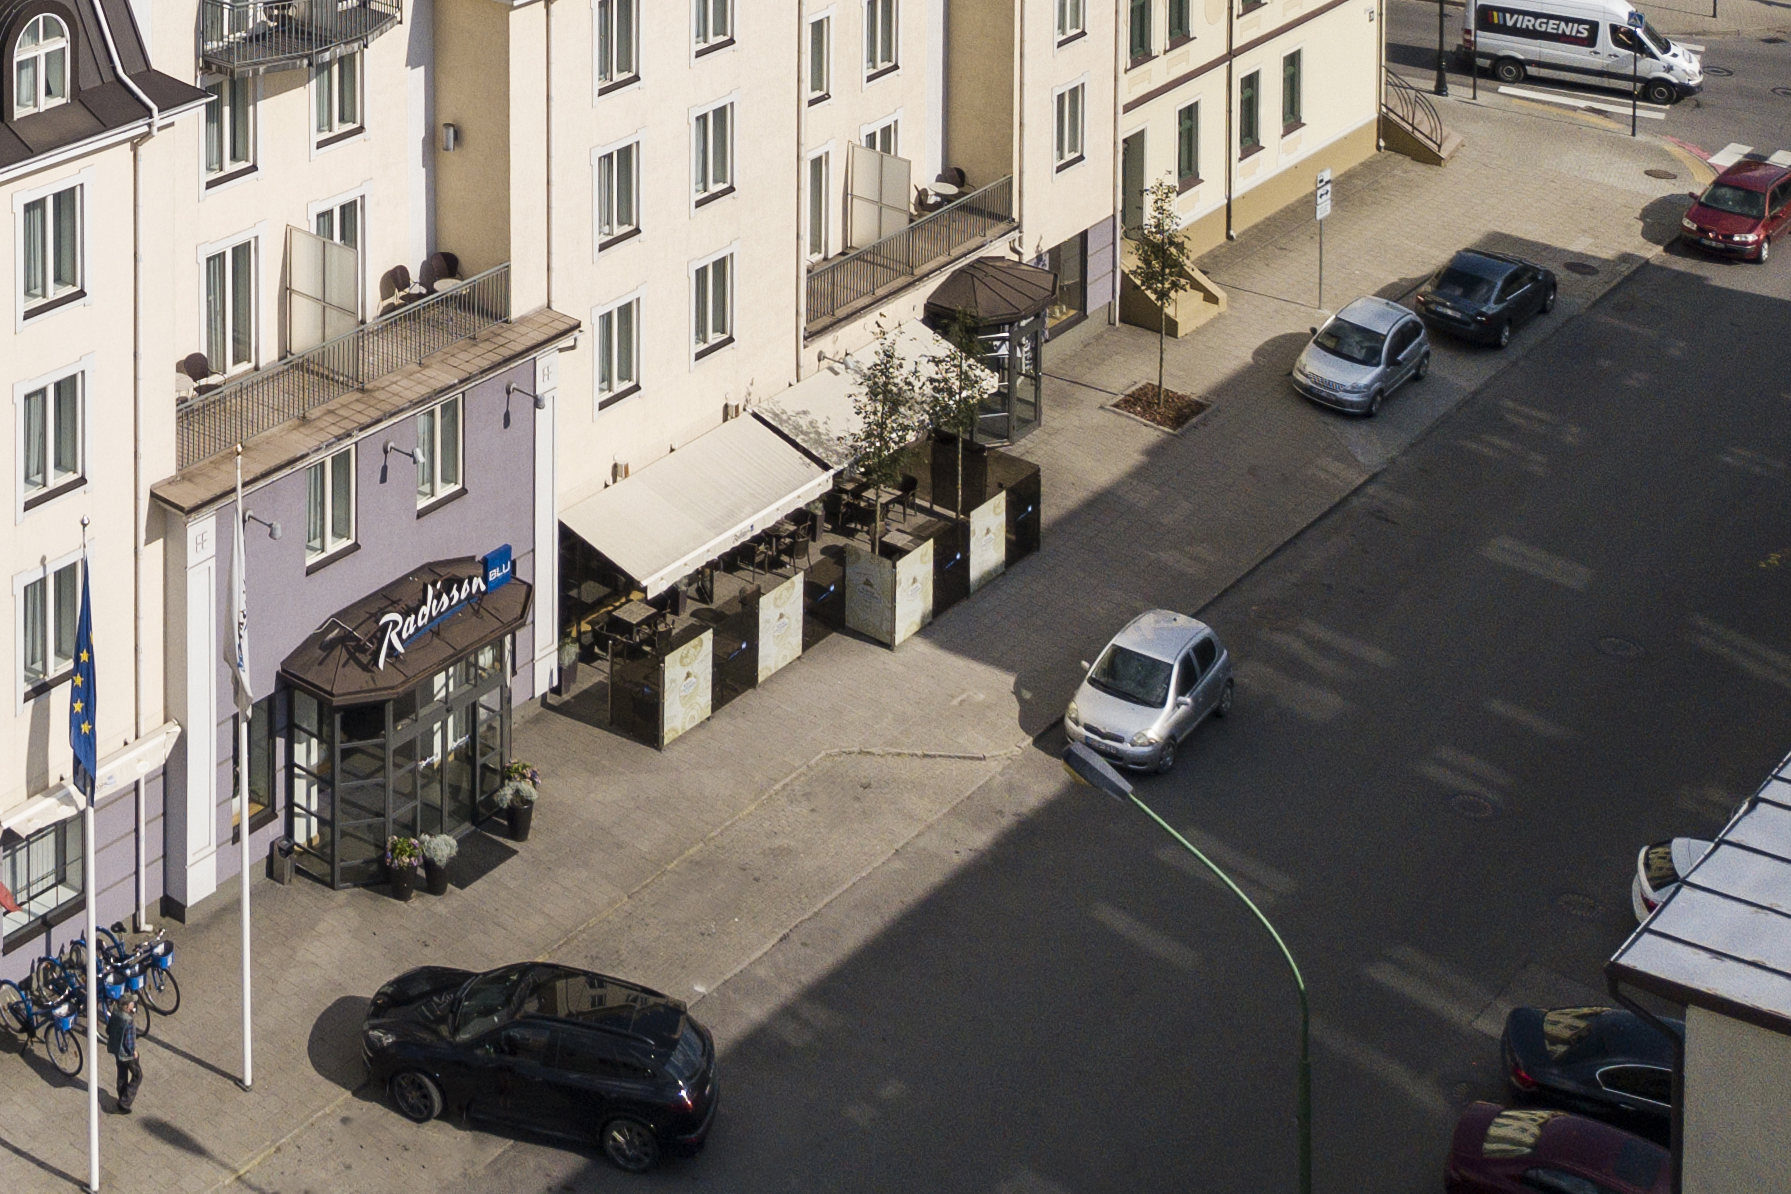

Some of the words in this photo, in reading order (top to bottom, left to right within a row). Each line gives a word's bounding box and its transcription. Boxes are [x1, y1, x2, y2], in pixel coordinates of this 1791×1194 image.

[1505, 12, 1590, 38] VIRGENIS
[378, 575, 486, 671] Radisson
[488, 560, 511, 582] BLU
